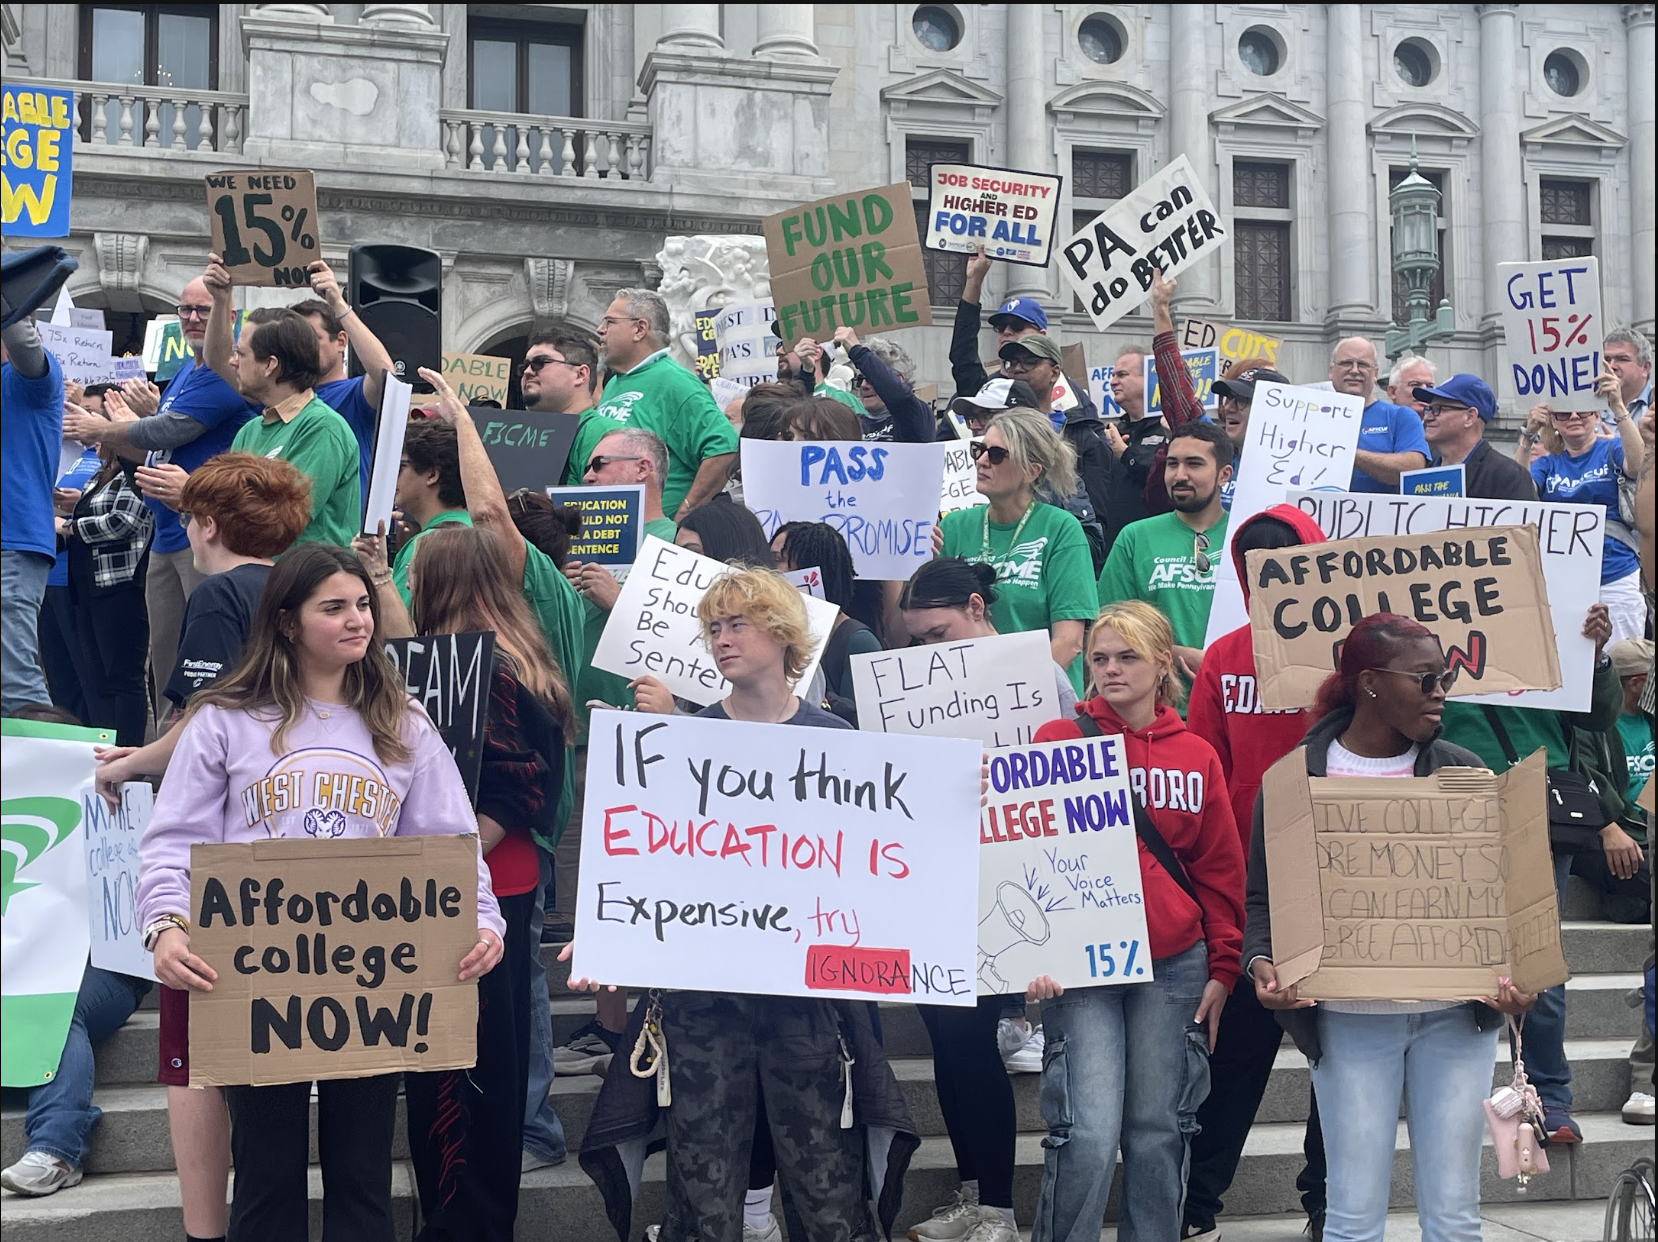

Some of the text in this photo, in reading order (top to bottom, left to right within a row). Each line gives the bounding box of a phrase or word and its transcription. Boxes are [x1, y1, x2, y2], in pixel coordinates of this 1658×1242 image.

[207, 175, 297, 191] WE NEED
[937, 173, 1051, 199] JOB SECURITY
[980, 192, 998, 200] AND
[780, 193, 894, 257] FUND
[943, 194, 1038, 220] HIGHER ED
[214, 193, 315, 267] 15%
[935, 211, 1042, 247] FOR ALL
[1063, 221, 1137, 280] PA
[1139, 184, 1193, 233] can
[810, 241, 894, 292] OUR
[1091, 208, 1224, 315] do BETTER
[1507, 267, 1588, 310] GET
[780, 281, 920, 341] FUTURE
[1184, 319, 1279, 365] ED CUTS
[1527, 313, 1593, 355] 15%
[1513, 350, 1599, 398] DONE!
[1265, 388, 1353, 422] Support
[1259, 421, 1346, 460] Higher
[799, 445, 890, 487] PASS
[1266, 460, 1327, 486] Ed!
[605, 514, 630, 525] NOT
[825, 490, 858, 509] the
[582, 529, 591, 540] A
[593, 529, 621, 540] DEBT
[819, 513, 931, 557] PROMISE
[1154, 555, 1187, 564] Council
[1257, 535, 1512, 588] AFFORDABLE
[636, 610, 670, 638] Be
[870, 644, 975, 698] FLAT
[879, 682, 1042, 733] Funding Is
[615, 722, 914, 820] IF you think
[240, 770, 402, 838] WEST CHESTER
[1064, 789, 1130, 834] NOW
[603, 805, 910, 879] EDUCATION IS
[1043, 847, 1088, 873] Your
[1370, 841, 1468, 883] MONEY
[199, 877, 461, 928] Affordable
[1065, 873, 1114, 891] Voice
[1329, 885, 1505, 921] CAN EARN MY
[596, 881, 860, 948] Expensive, try
[233, 933, 418, 989] college
[812, 952, 972, 996] IGNORANCE
[1085, 940, 1144, 978] 15%
[250, 992, 433, 1055] NOW!
